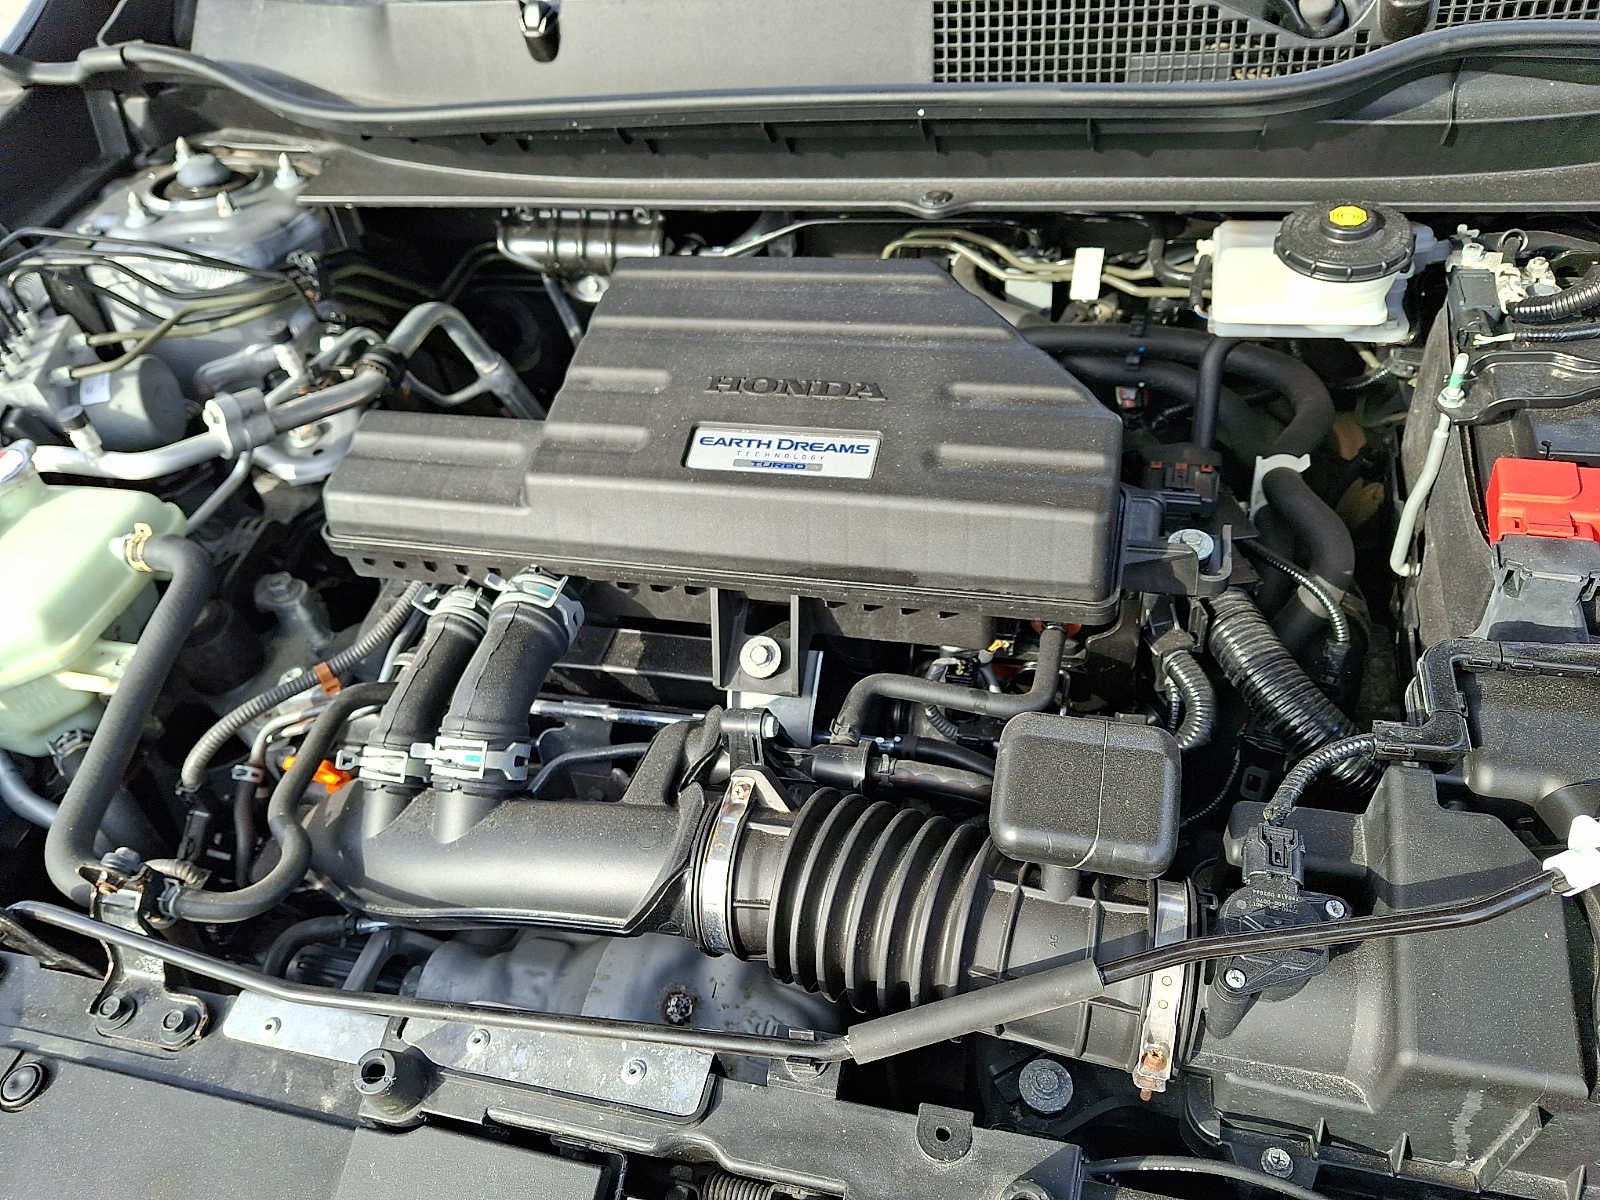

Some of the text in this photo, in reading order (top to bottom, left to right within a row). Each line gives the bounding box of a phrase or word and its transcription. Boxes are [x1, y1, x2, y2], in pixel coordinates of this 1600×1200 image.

[704, 375, 888, 401] HONDA
[699, 436, 871, 455] EARTH DREAMS
[736, 450, 825, 461] TECHNOLOGY
[751, 460, 806, 470] TURBO
